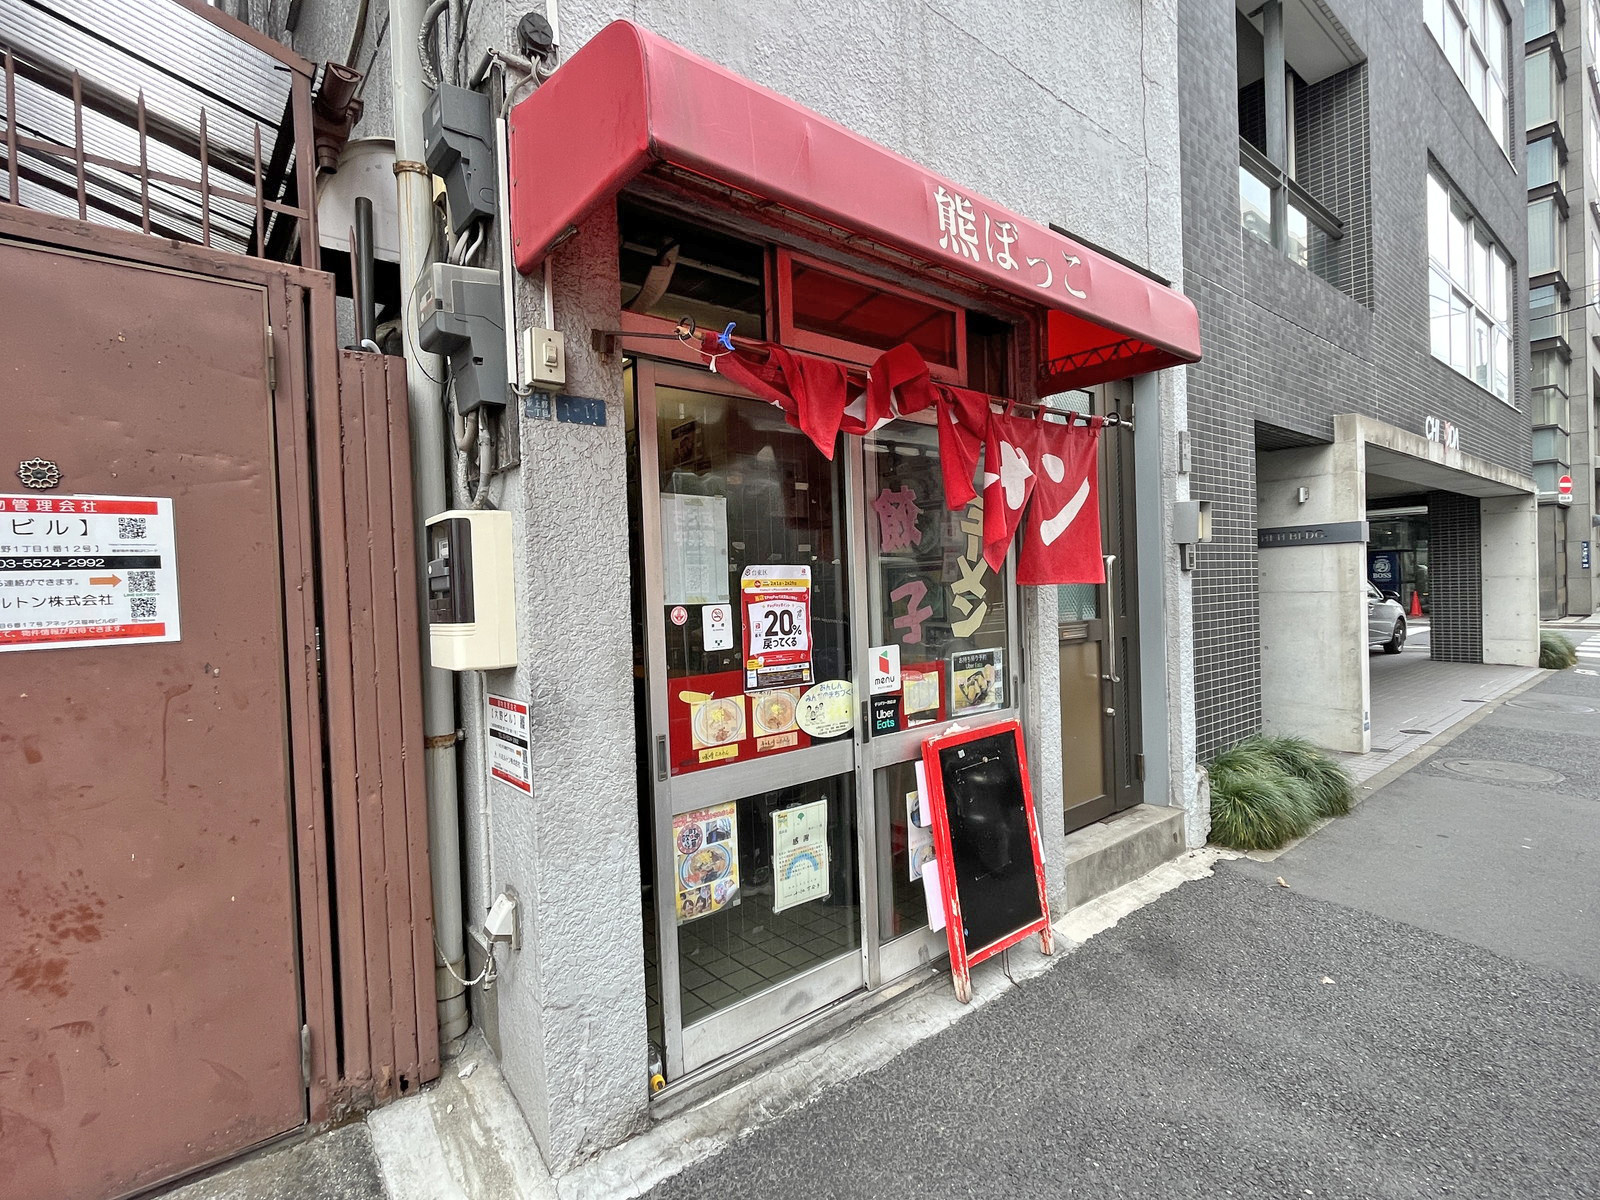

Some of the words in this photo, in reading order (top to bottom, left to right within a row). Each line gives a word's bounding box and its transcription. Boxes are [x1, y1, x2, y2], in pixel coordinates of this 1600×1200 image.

[933, 185, 1086, 299] 熊ぼっこ
[1289, 528, 1327, 541] BLDG.
[764, 609, 802, 637] 20%
[763, 637, 798, 650] 戻ってくる
[874, 676, 895, 685] menu
[876, 709, 894, 719] Uber
[877, 719, 895, 729] Eats
